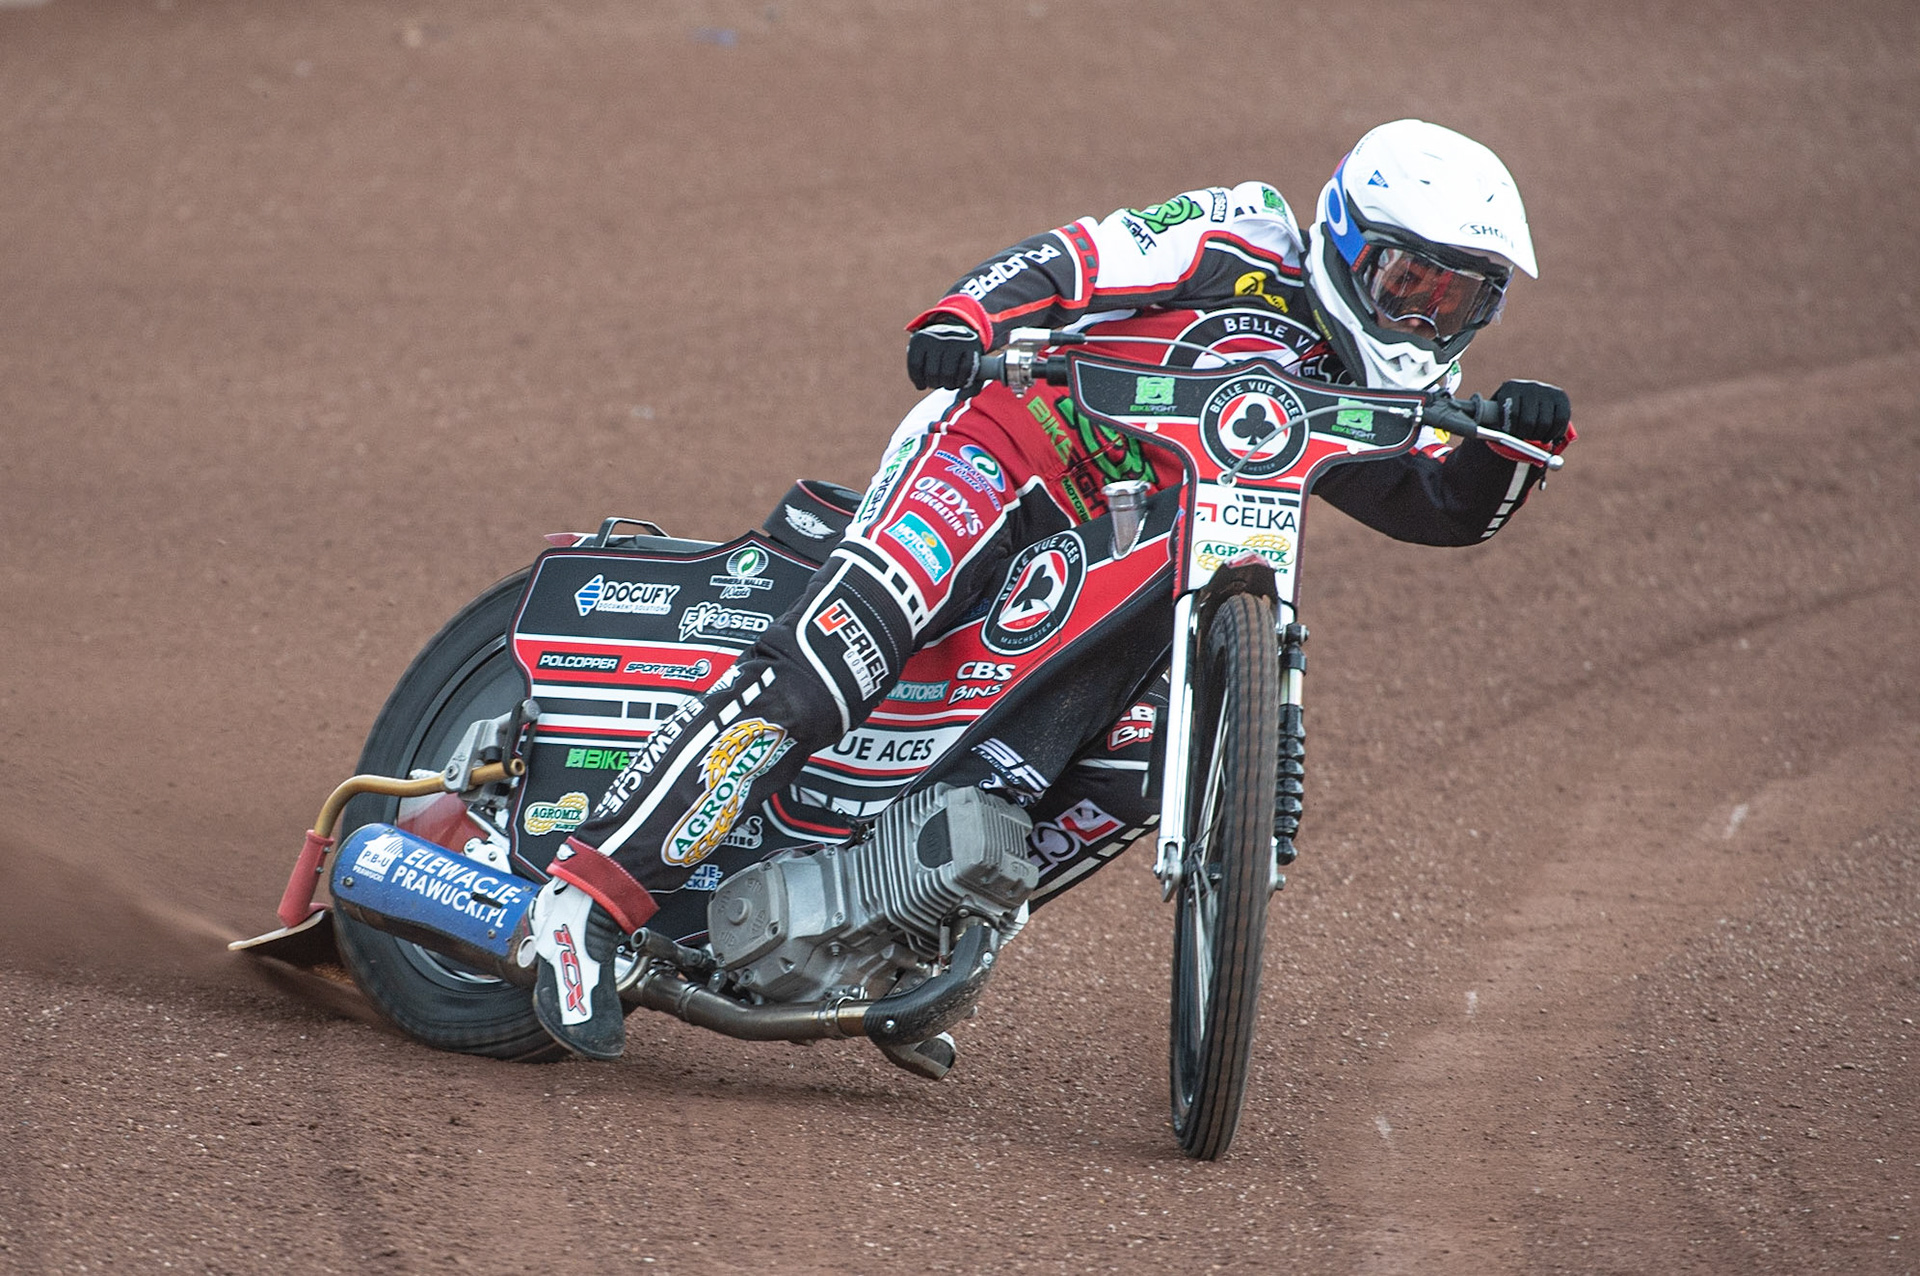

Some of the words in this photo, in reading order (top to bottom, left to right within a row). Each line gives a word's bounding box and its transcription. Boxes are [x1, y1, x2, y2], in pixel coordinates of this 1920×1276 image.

[1224, 316, 1288, 338] BELLE
[1209, 384, 1244, 414] BELLE
[1248, 381, 1274, 395] VUE
[909, 490, 967, 537] CONCRETING
[914, 476, 984, 536] OLDY'S
[1222, 504, 1297, 533] CELKA
[896, 522, 944, 574] MOTOREX
[1033, 536, 1060, 554] VUE
[1059, 538, 1080, 564] ACES
[602, 584, 677, 604] DOCUFY
[827, 601, 889, 691] TERIEL
[1000, 622, 1052, 645] MANCHESTER
[539, 656, 618, 670] POLCOPPER
[956, 662, 1017, 681] CBS
[888, 681, 949, 702] MOTOREX
[949, 683, 1004, 704] BINS
[832, 735, 875, 762] UE
[876, 737, 935, 762] ACES
[675, 733, 776, 857] AGROMIX
[531, 808, 582, 821] AGROMIX
[390, 865, 508, 928] PRAWUCKI.PL
